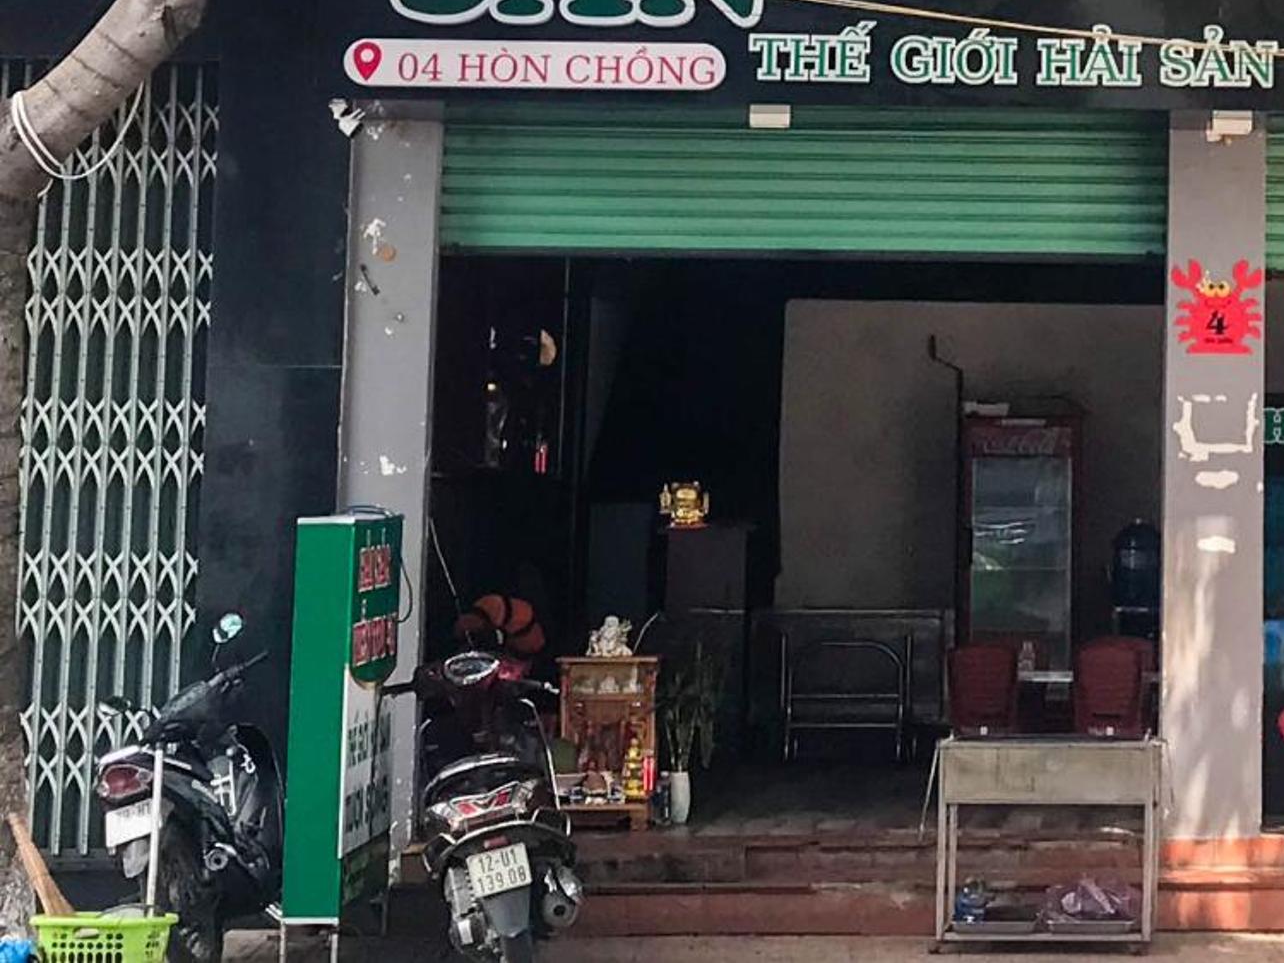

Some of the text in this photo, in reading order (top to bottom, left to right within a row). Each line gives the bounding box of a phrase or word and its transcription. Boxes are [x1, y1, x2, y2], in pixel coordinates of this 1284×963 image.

[399, 46, 715, 85] 04 HÒN CHỒNG
[749, 20, 877, 82] THẾ
[891, 28, 1018, 85] GIỚI
[1036, 25, 1142, 86] HẢI
[1160, 25, 1277, 89] SẢN
[1206, 310, 1229, 334] 4
